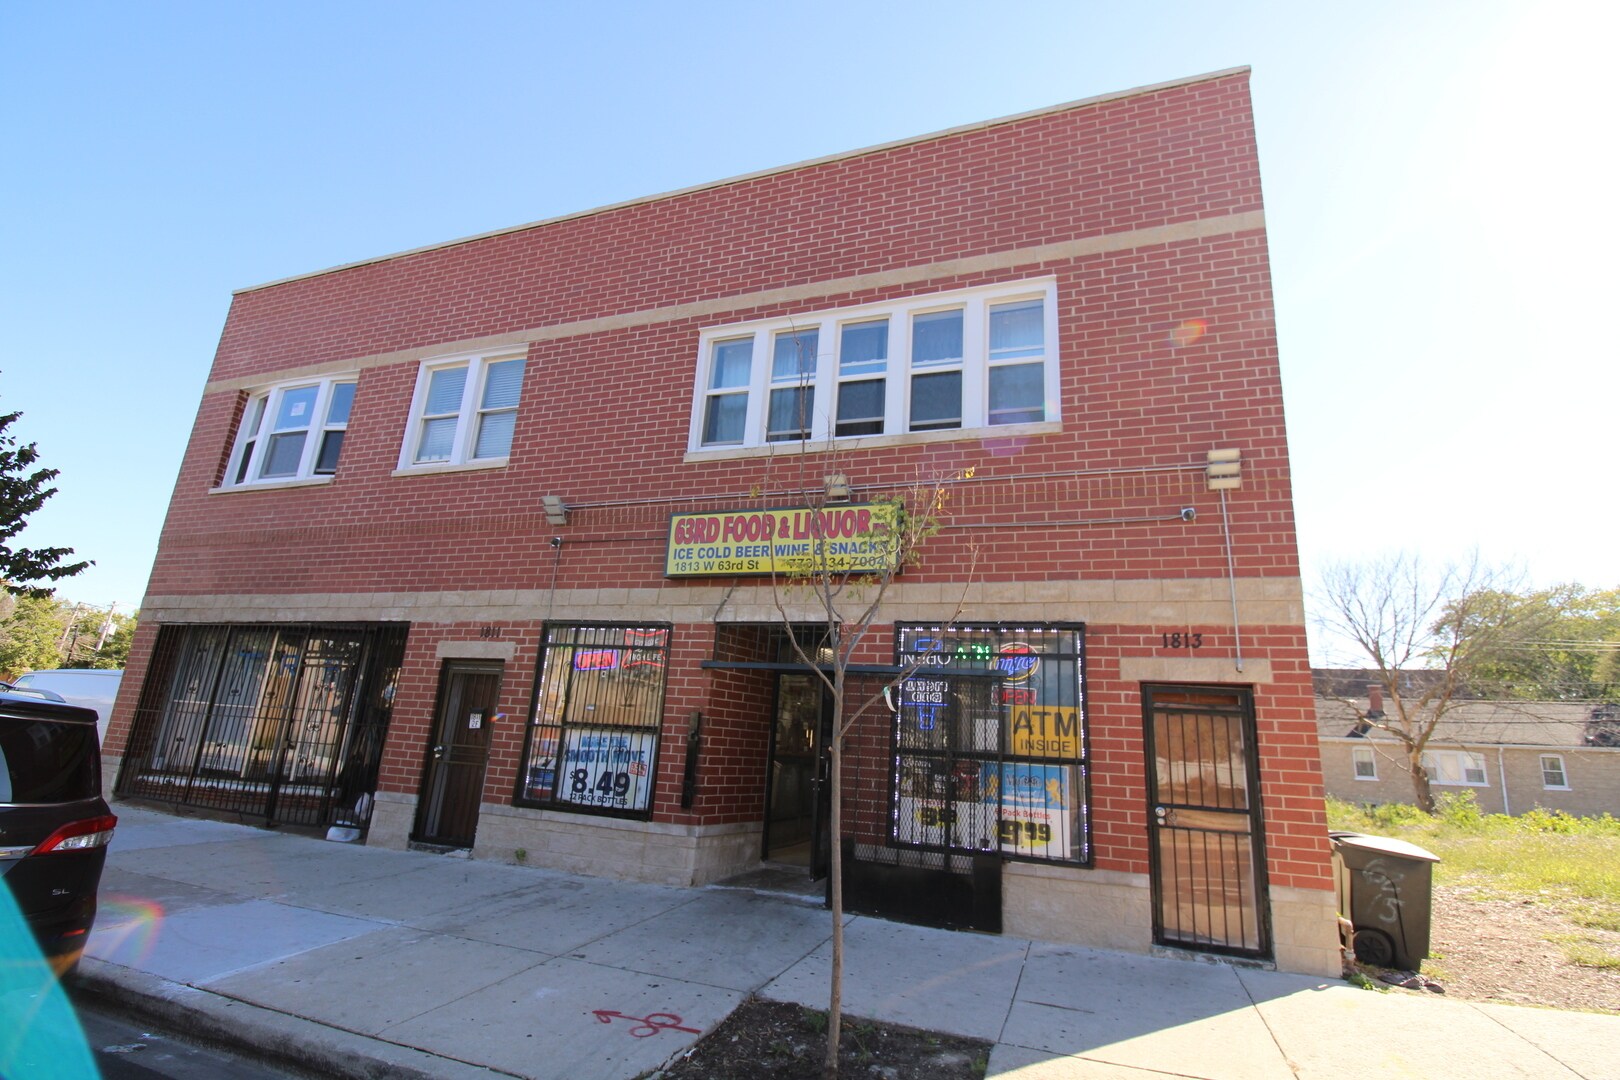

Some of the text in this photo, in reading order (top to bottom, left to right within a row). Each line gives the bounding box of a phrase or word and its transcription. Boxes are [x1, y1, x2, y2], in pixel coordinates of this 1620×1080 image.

[674, 516, 720, 545] 63RD
[722, 512, 776, 543] FOOD
[778, 516, 790, 539] &
[793, 509, 871, 541] LIQUOR
[673, 548, 693, 560] ICE
[697, 546, 731, 560] COLD
[735, 544, 769, 558] BEER
[774, 543, 809, 557] WINE
[829, 541, 889, 556] SNACK
[674, 558, 760, 572] 1813 W 63rd St
[480, 626, 500, 638] 1811
[1163, 632, 1202, 649] 1813
[577, 652, 613, 668] OPEN
[1013, 710, 1078, 737] ATM
[1021, 738, 1071, 753] INSIDE
[1003, 808, 1021, 817] Pack
[1023, 809, 1052, 820] Bottles
[52, 888, 70, 896] SL
